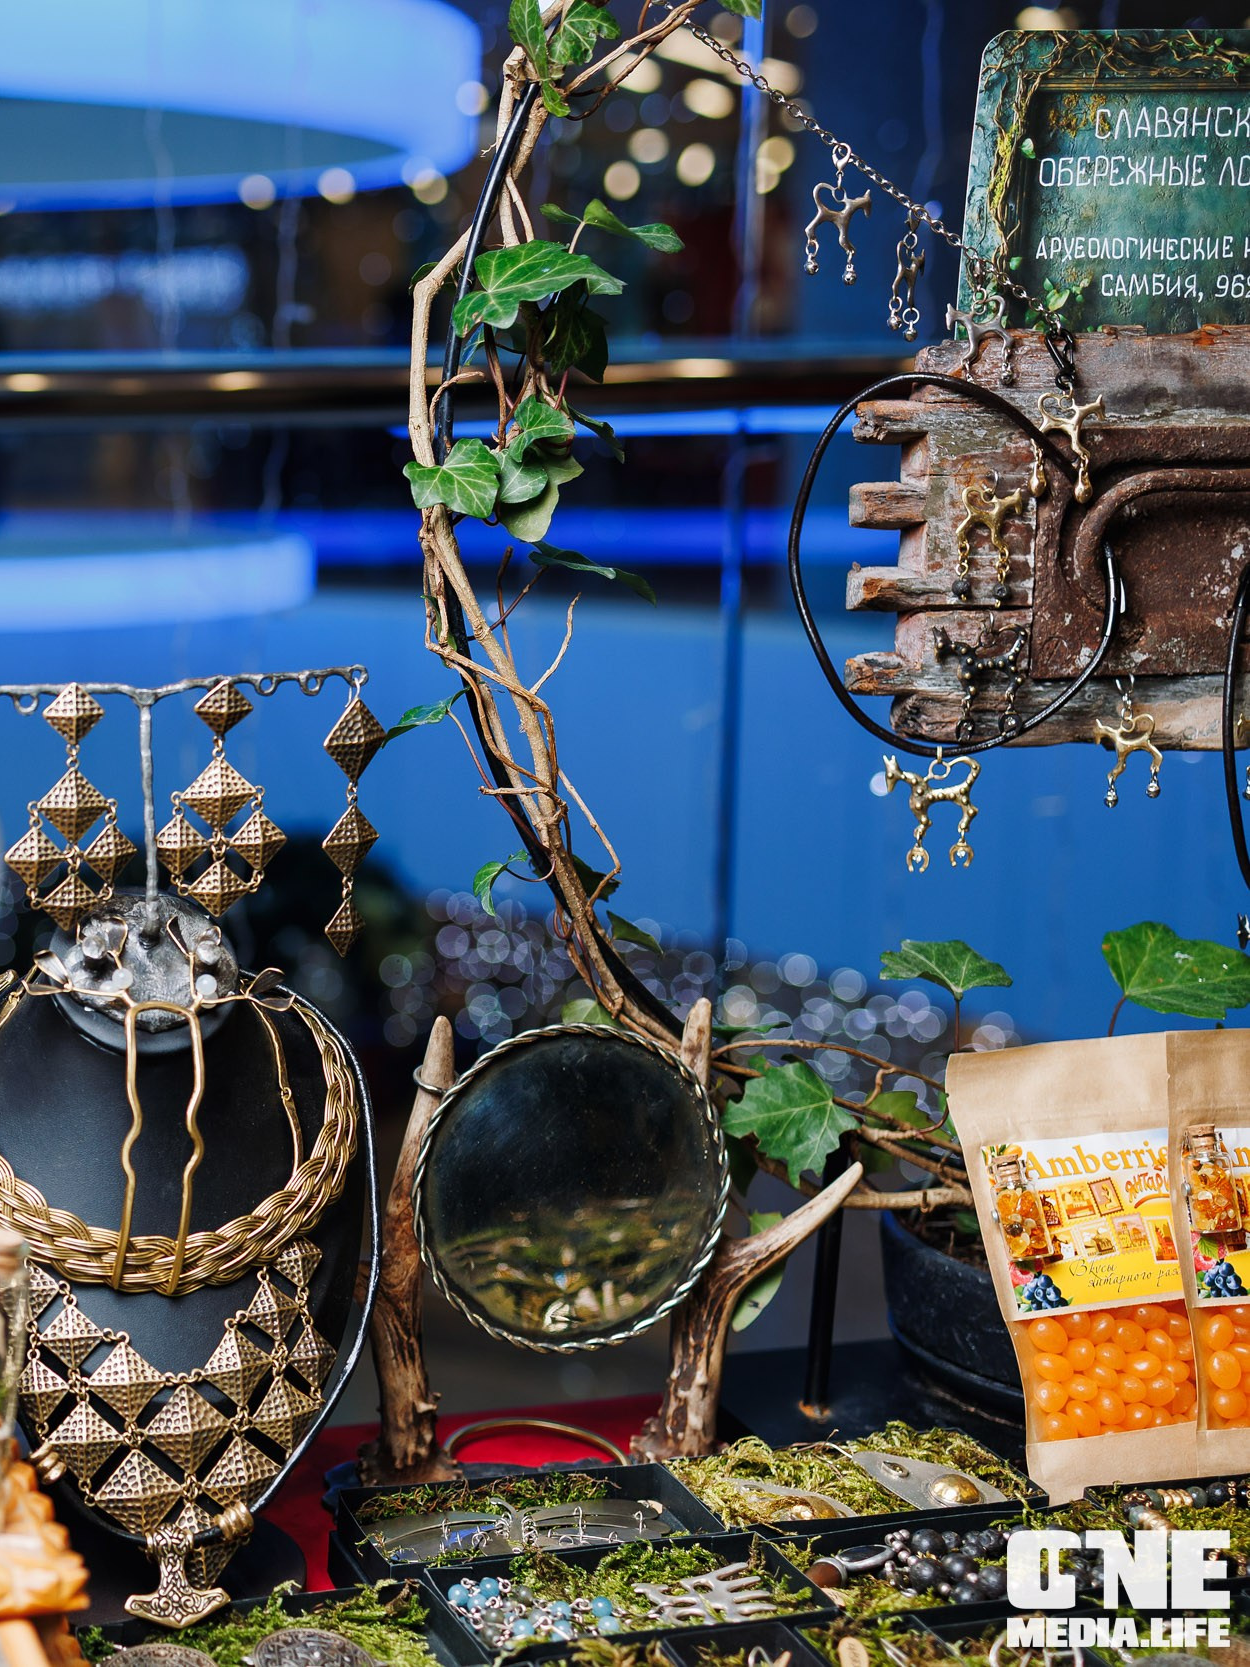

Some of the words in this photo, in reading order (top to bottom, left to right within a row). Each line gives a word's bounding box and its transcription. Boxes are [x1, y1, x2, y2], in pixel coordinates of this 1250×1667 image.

[1095, 106, 1250, 140] СЛАВЯНСК
[1038, 154, 1208, 188] ОБЕРЕЖНЫЕ
[1035, 235, 1234, 261] АРХЕОЛОГИЧЕСКИЕ
[1101, 272, 1204, 303] САМБИЯ,
